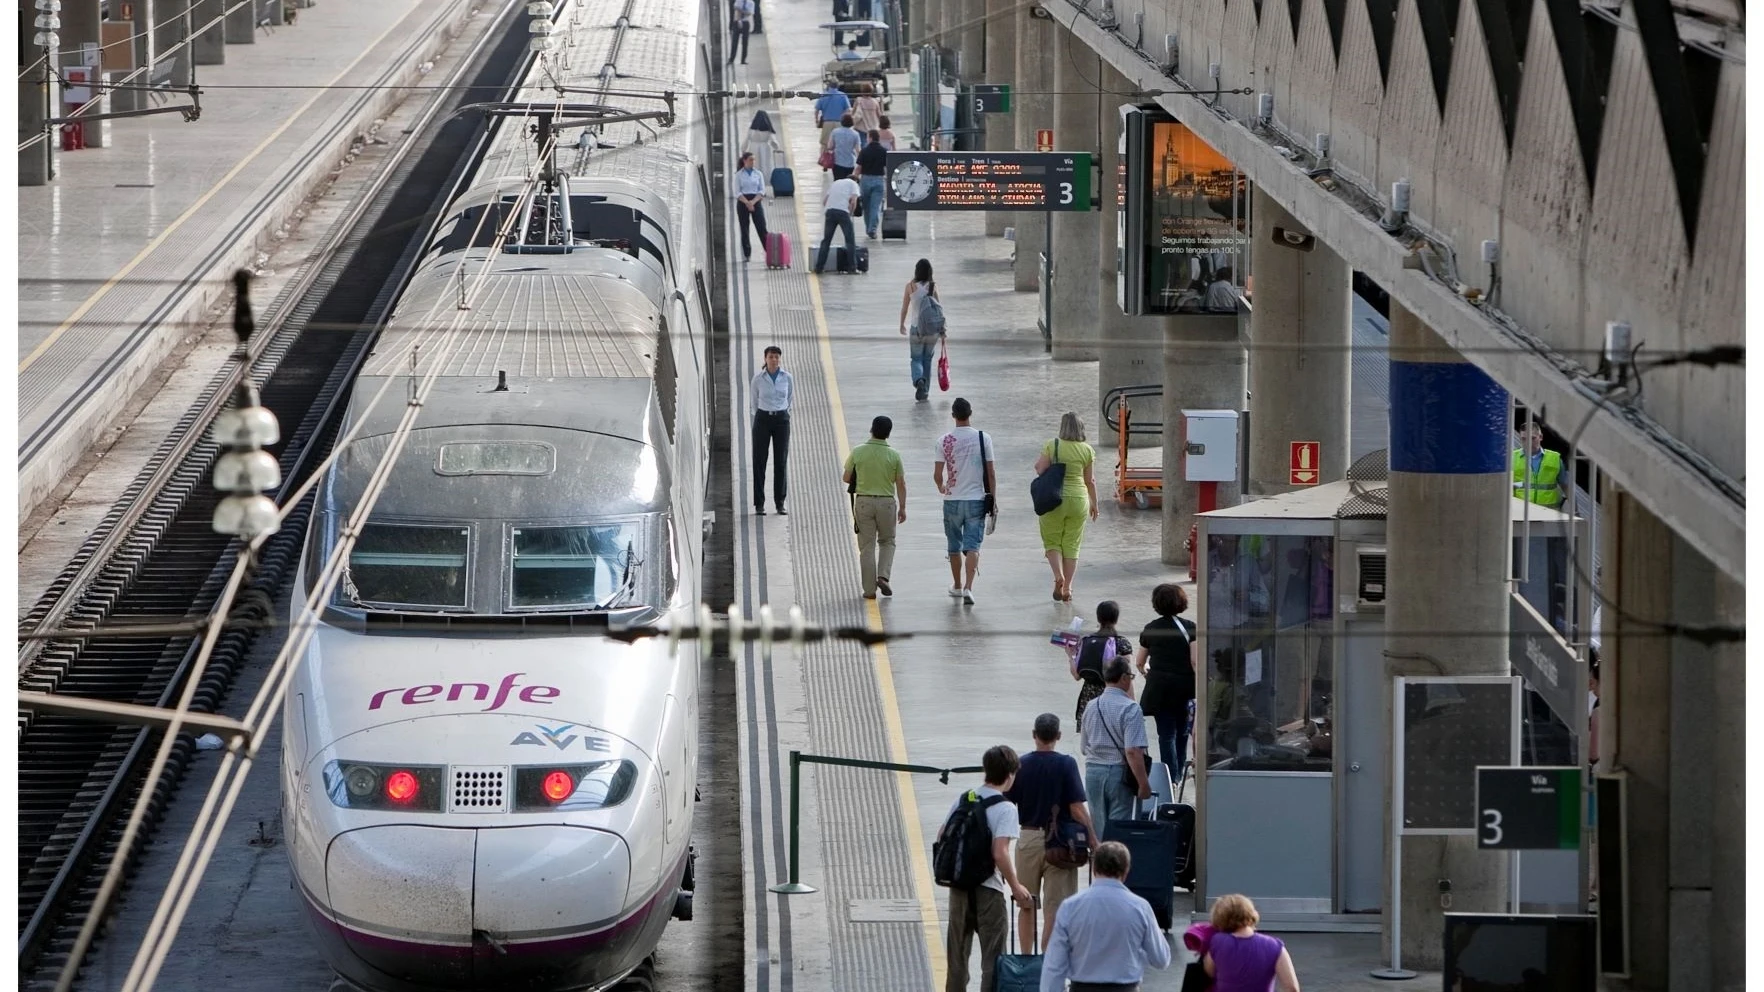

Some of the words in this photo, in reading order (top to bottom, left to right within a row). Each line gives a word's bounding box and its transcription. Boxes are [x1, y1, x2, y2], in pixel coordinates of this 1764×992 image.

[976, 98, 984, 112] 3
[1059, 182, 1073, 204] 3
[1161, 236, 1196, 245] Seguimos
[1197, 236, 1234, 245] trabajando
[368, 672, 560, 712] renfe
[510, 725, 611, 752] AVE
[1530, 774, 1548, 785] Vía
[1482, 808, 1504, 845] 3
